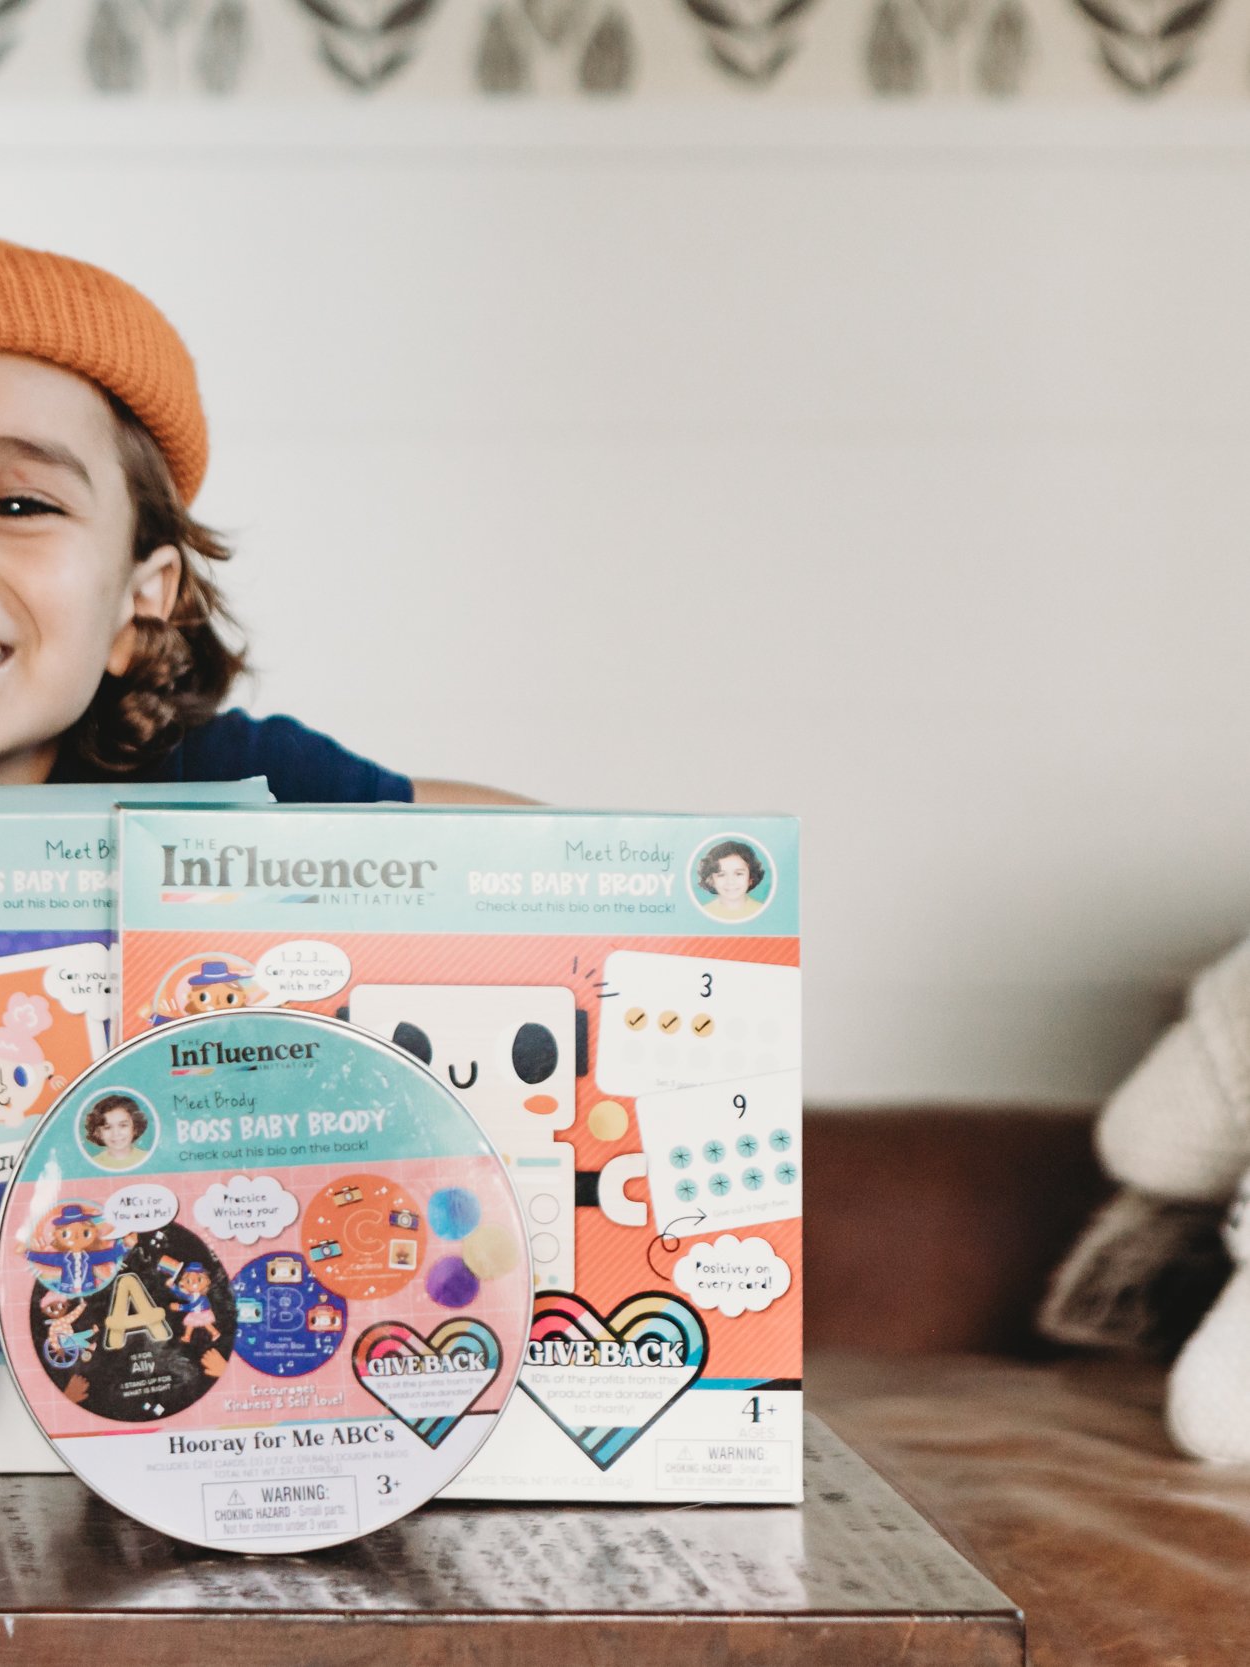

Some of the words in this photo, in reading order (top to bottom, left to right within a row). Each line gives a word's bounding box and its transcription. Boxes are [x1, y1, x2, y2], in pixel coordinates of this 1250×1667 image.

[45, 839, 93, 860] Meet
[182, 838, 217, 849] THE
[564, 840, 614, 863] Meet
[160, 844, 439, 889] Influencer
[13, 869, 70, 893] BABY
[468, 870, 523, 896] BOSS
[531, 872, 590, 897] BABY
[598, 873, 676, 898] BRODY
[3, 899, 24, 909] out
[27, 897, 46, 909] his
[49, 897, 70, 909] bio
[73, 900, 90, 909] on
[322, 893, 425, 905] INITIATIVE
[476, 900, 517, 913] Check
[520, 902, 543, 913] out
[546, 901, 565, 913] his
[568, 901, 590, 913] bio
[593, 905, 611, 913] on
[613, 902, 636, 913] the
[639, 902, 676, 914] back!
[265, 964, 290, 977] Can
[291, 967, 310, 980] you
[313, 966, 345, 977] count
[279, 980, 305, 991] with
[308, 979, 330, 991] me?
[700, 972, 713, 998] 3
[170, 1040, 320, 1068] Influencer
[173, 1094, 209, 1111] Meet
[733, 1094, 748, 1119] 9
[176, 1117, 232, 1144] BOSS
[240, 1113, 299, 1141] BABY
[308, 1109, 387, 1137] BRODY
[179, 1149, 218, 1162] Check
[222, 1149, 243, 1160] out
[246, 1147, 264, 1158] his
[267, 1145, 288, 1158] bio
[290, 1146, 307, 1156] on
[310, 1143, 331, 1155] the
[334, 1141, 369, 1154] back!
[256, 1204, 279, 1217] your
[698, 1280, 738, 1292] every
[739, 1278, 773, 1290] card!
[104, 1272, 174, 1351] A
[367, 1354, 423, 1377] GIVE
[422, 1350, 486, 1375] BACK
[524, 1340, 599, 1367] GIVE
[599, 1340, 685, 1368] BACK
[568, 1374, 587, 1384] the
[589, 1374, 625, 1387] profits
[628, 1374, 656, 1384] from
[658, 1375, 680, 1385] this
[251, 1384, 316, 1398] Encourages
[547, 1388, 592, 1399] product
[224, 1399, 270, 1412] Kindness
[274, 1398, 283, 1410] &
[287, 1396, 311, 1410] Self
[313, 1392, 344, 1407] Love!
[168, 1434, 247, 1455] Hooray
[253, 1431, 286, 1450] for
[293, 1429, 324, 1447] Me
[330, 1424, 395, 1444] ABC's
[261, 1485, 330, 1503] WARNING:
[214, 1508, 254, 1522] CHOKING
[256, 1507, 290, 1520] HAZARD
